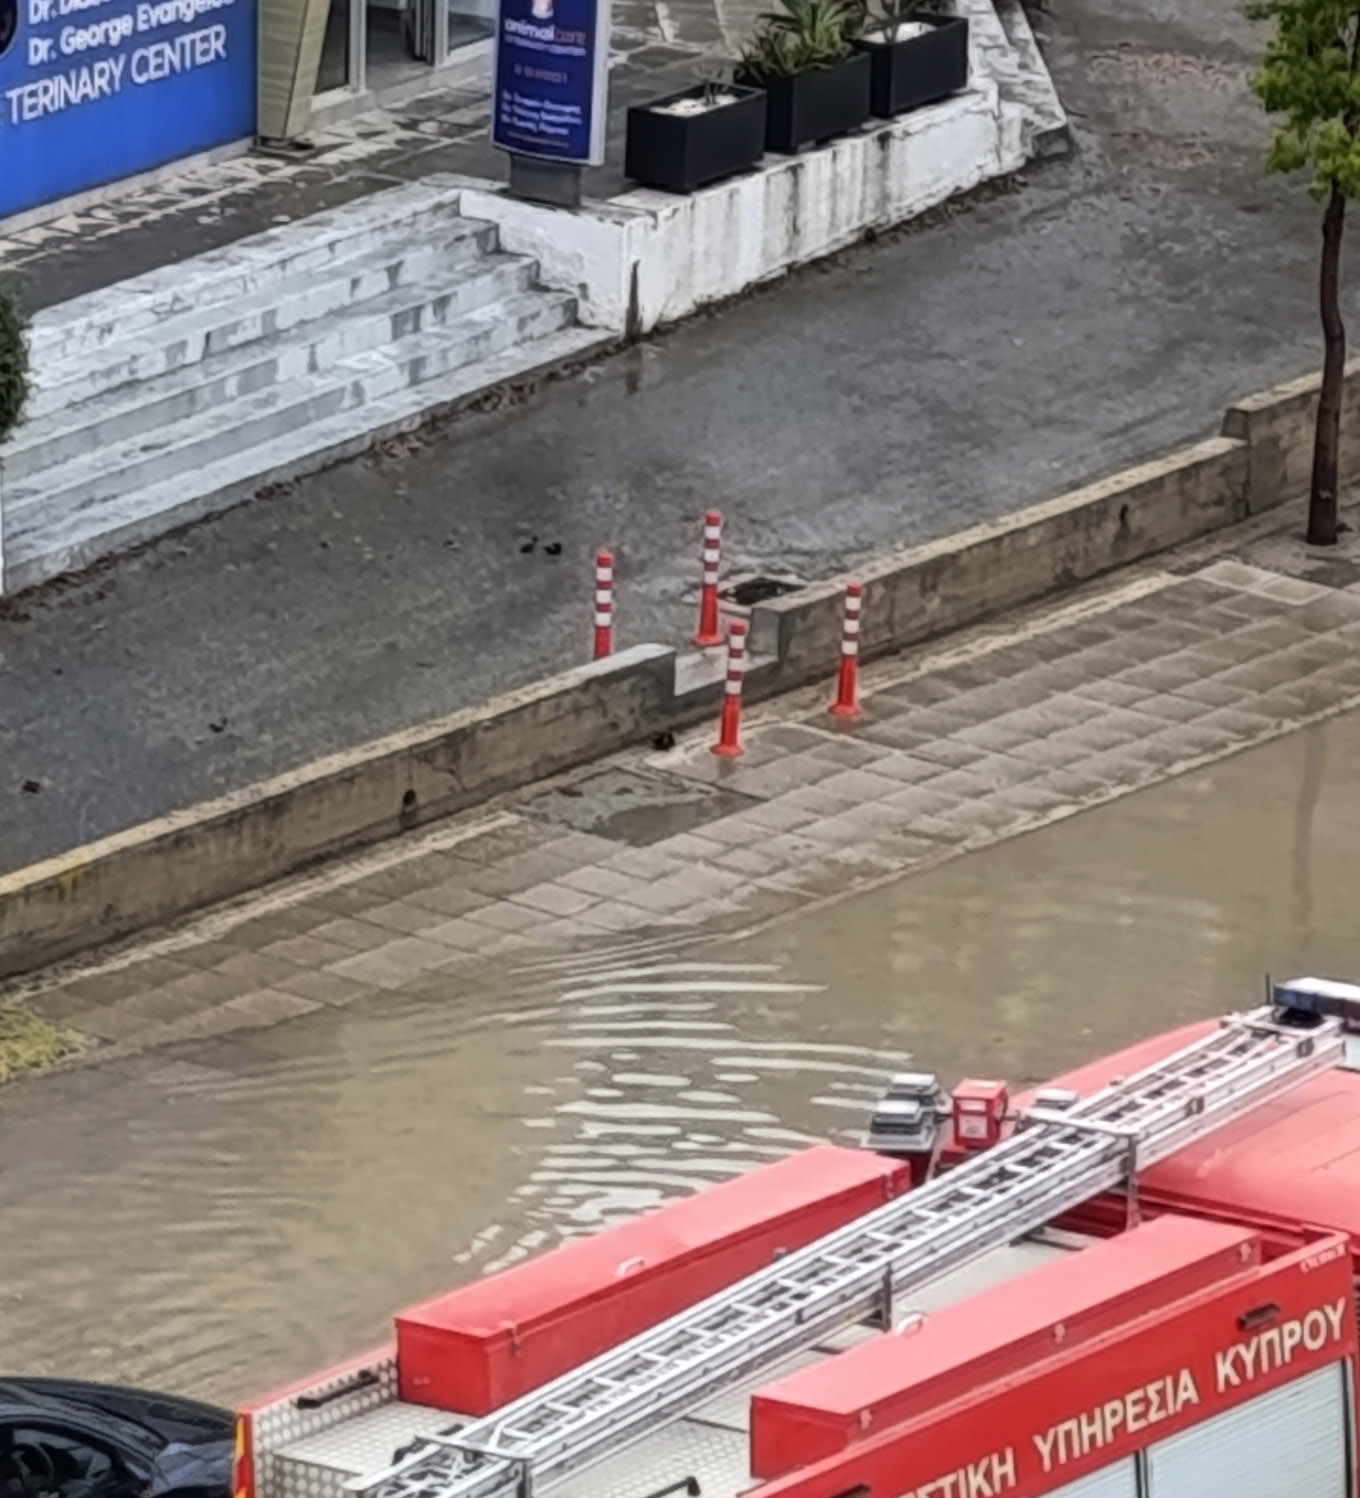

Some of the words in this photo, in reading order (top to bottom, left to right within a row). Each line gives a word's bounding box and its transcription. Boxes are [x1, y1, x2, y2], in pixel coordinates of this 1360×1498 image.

[28, 37, 57, 66] Dr.
[60, 14, 134, 55] George
[131, 23, 228, 85] CENTER
[1033, 1368, 1200, 1473] ΥΠΗΡΕΣΙΑ
[1215, 1297, 1346, 1393] ΚΥΠΡΟΥ
